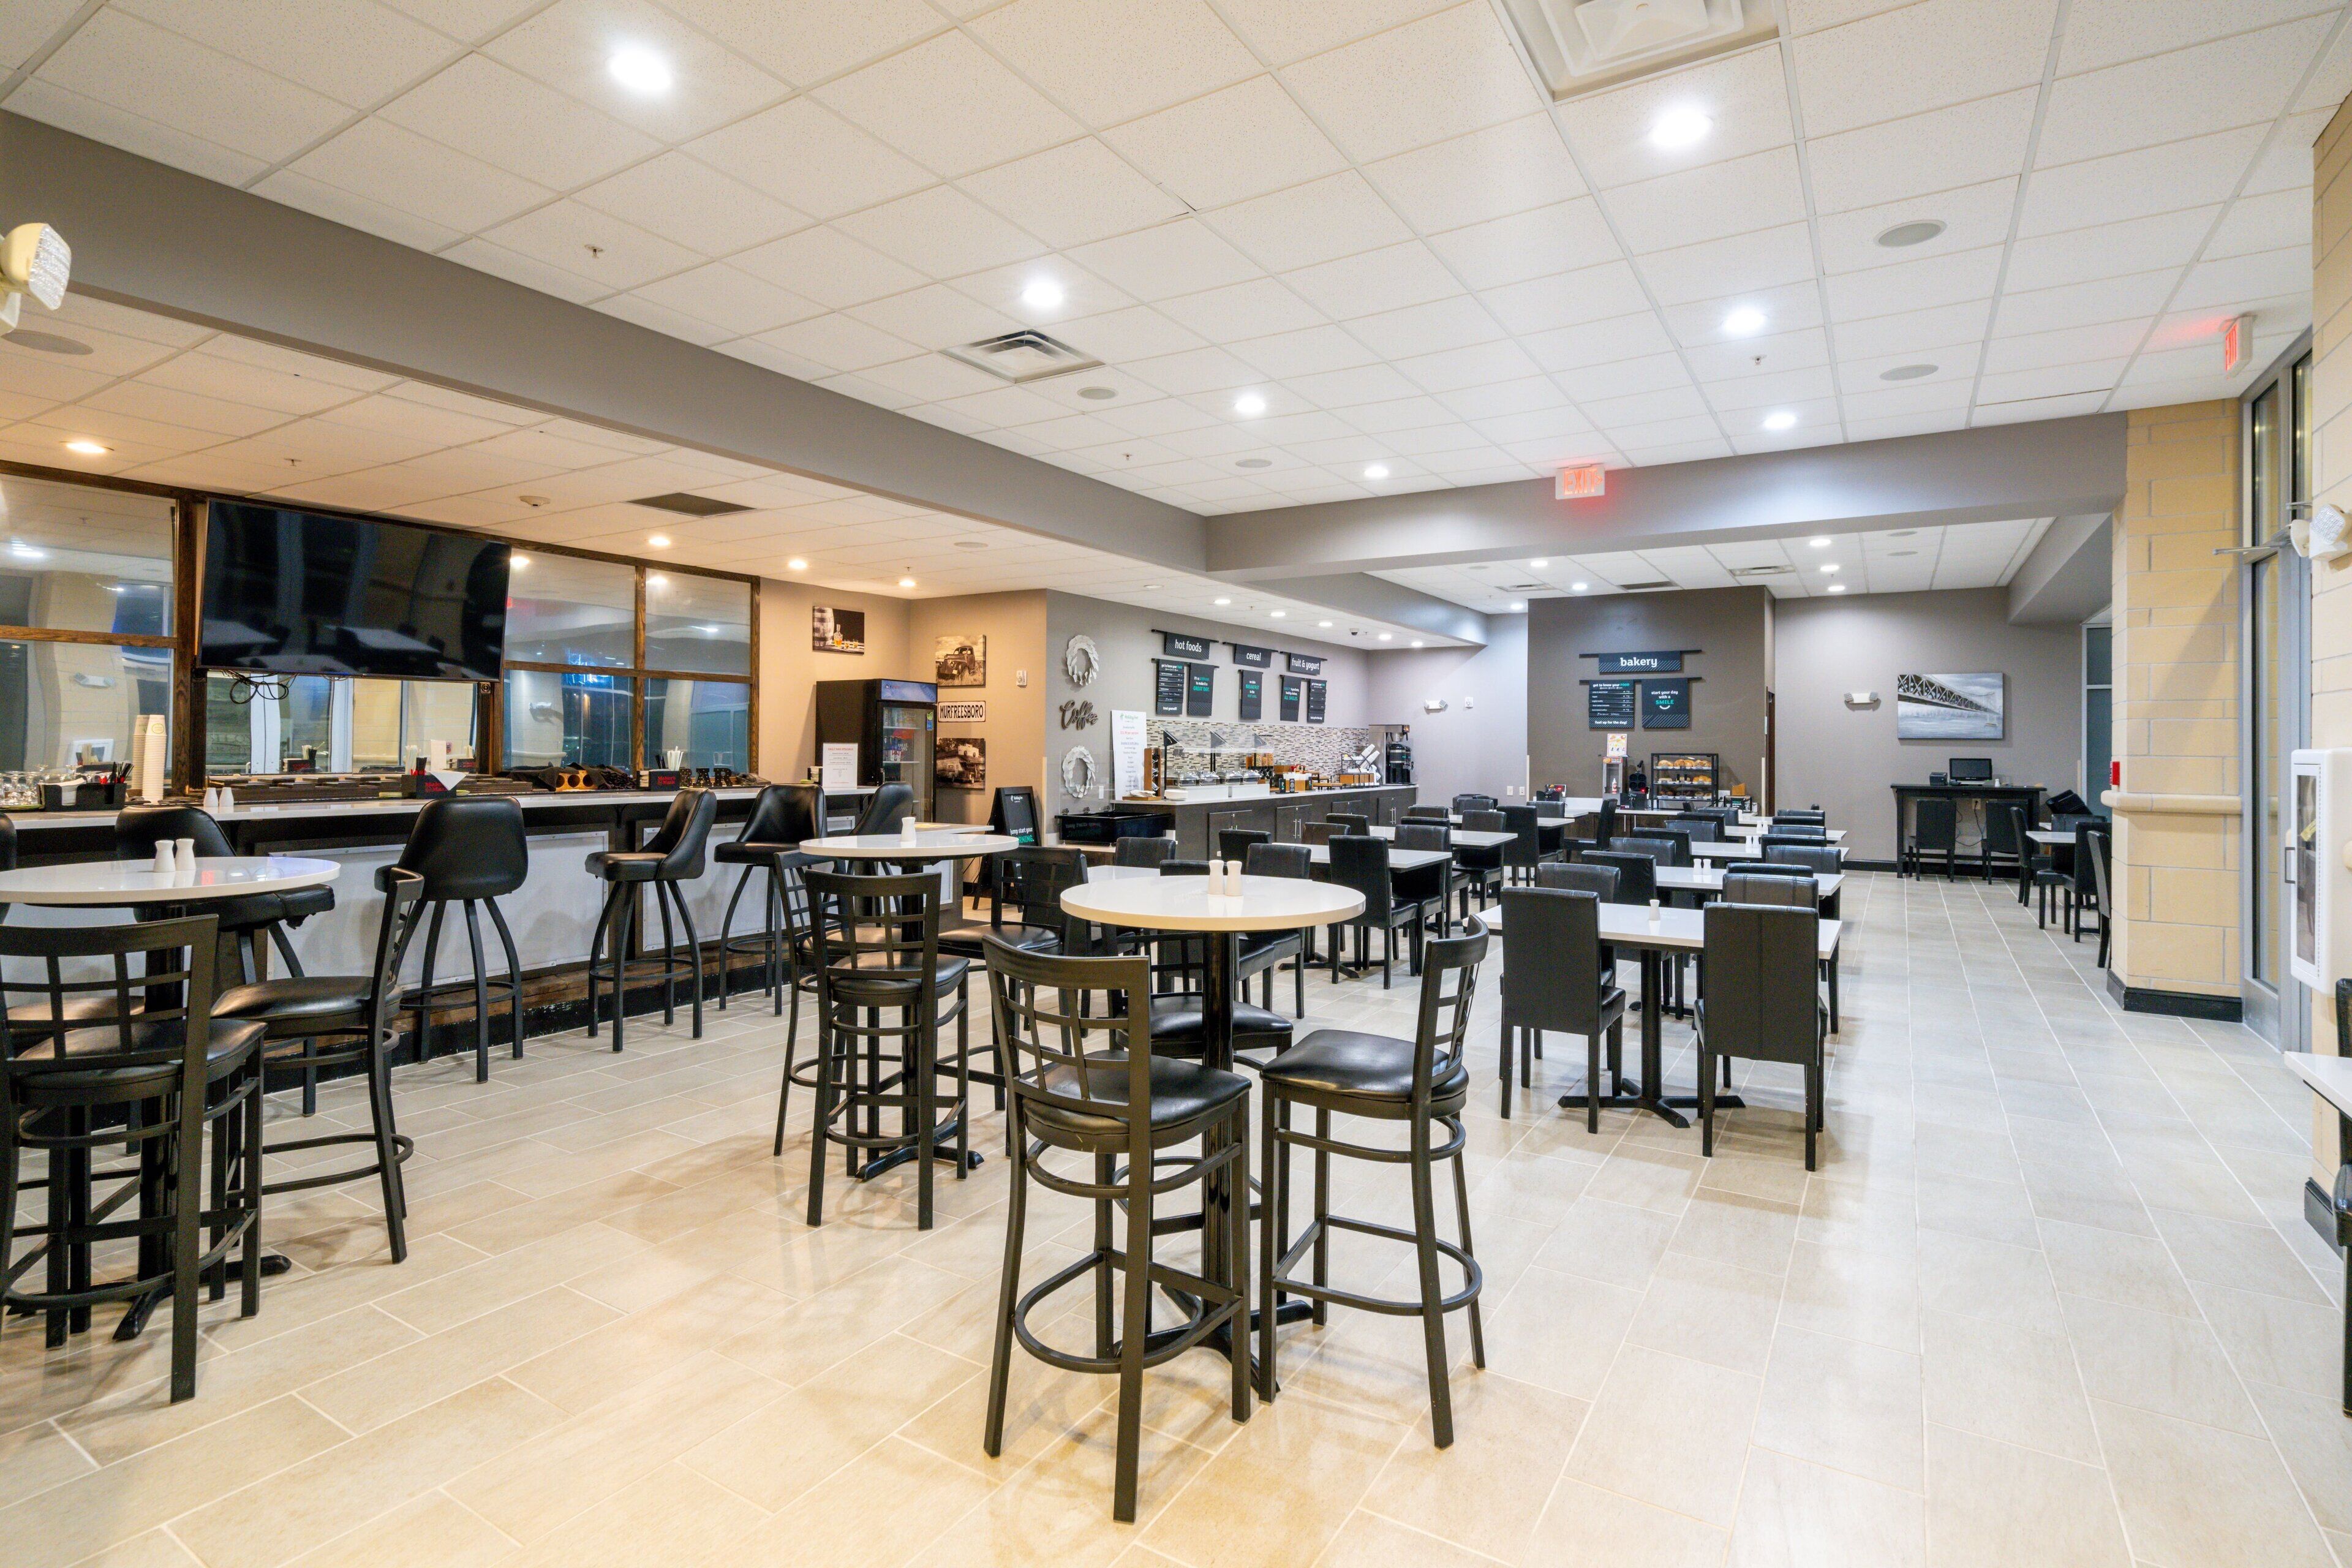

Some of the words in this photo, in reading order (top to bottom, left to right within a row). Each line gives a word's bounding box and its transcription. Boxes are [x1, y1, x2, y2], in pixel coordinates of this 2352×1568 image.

[1564, 468, 1597, 495] EXIT
[1175, 639, 1185, 649] hot
[1186, 641, 1202, 652] foods
[1246, 652, 1261, 662] cereal
[1620, 657, 1657, 668] bakery
[1292, 658, 1302, 667] fruit
[1306, 662, 1319, 671] yogurt
[940, 704, 984, 719] MURFREESBORO
[1059, 699, 1099, 731] Coffee
[679, 768, 733, 787] BAR
[1019, 835, 1035, 843] RNING.
